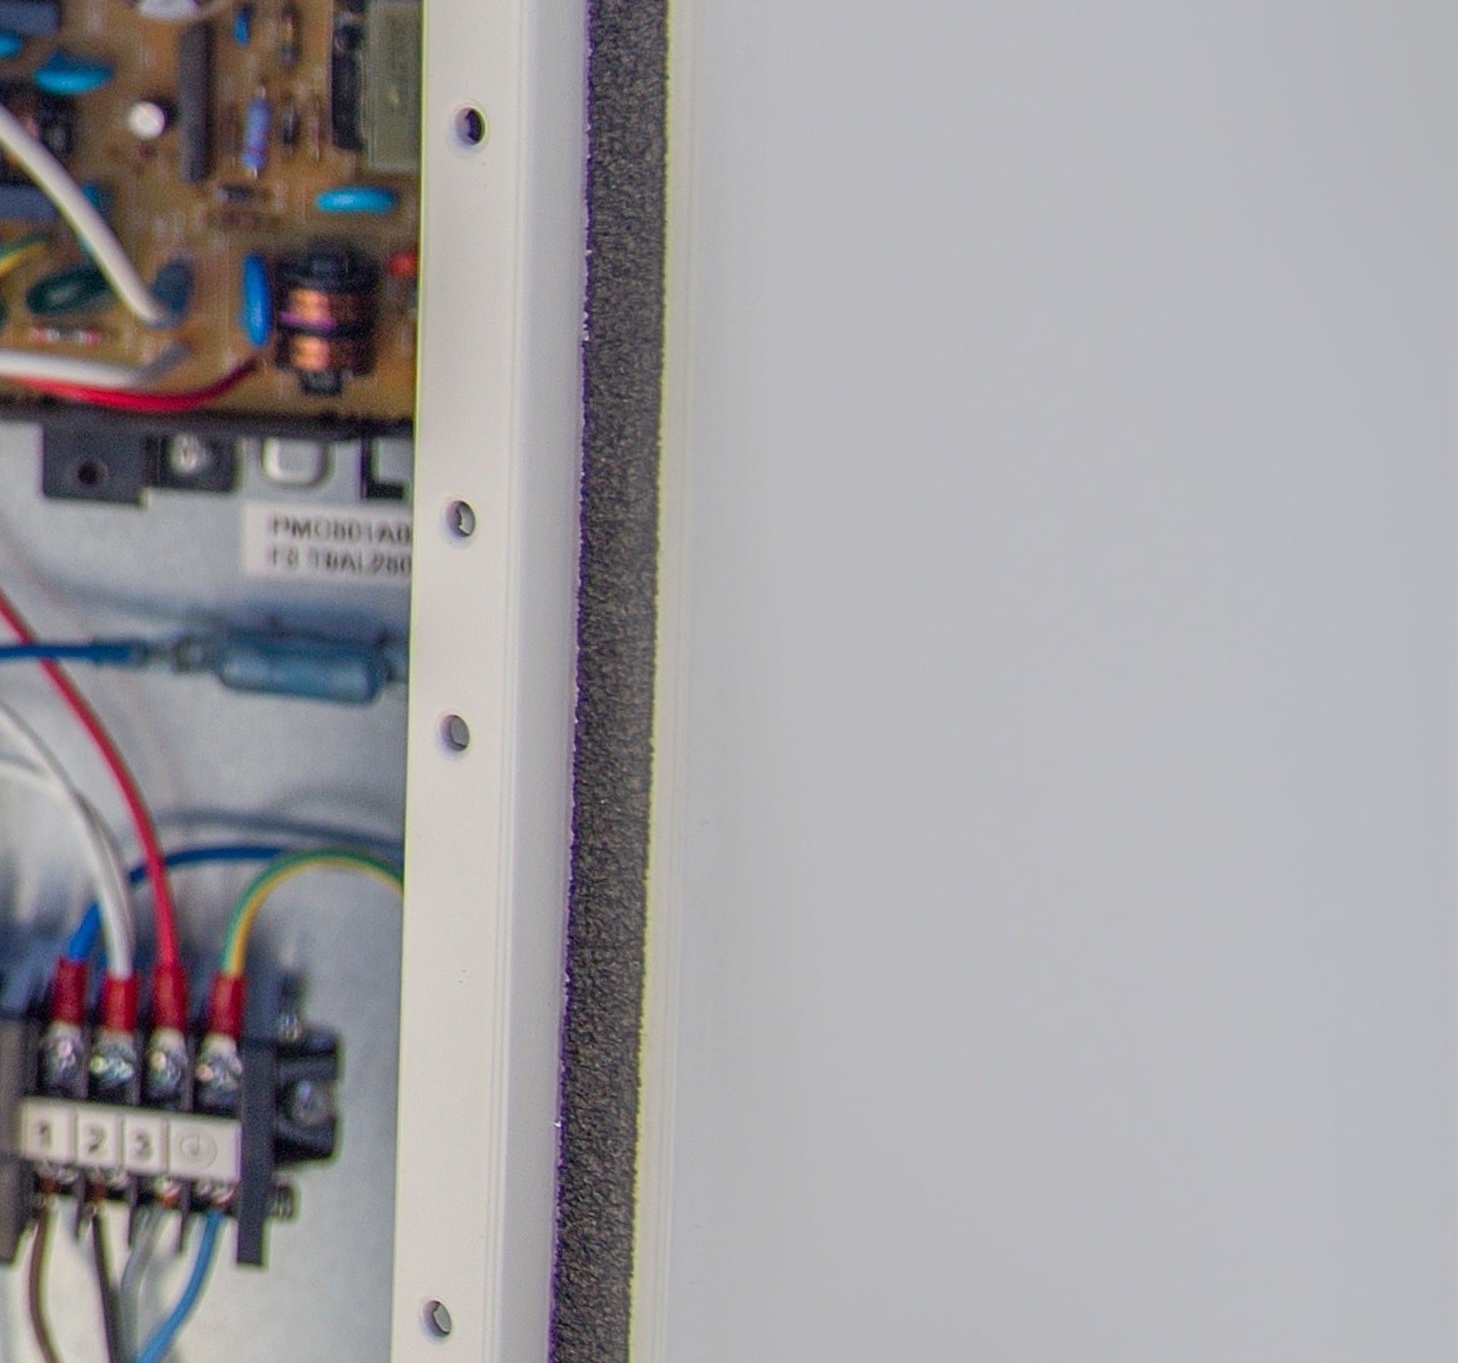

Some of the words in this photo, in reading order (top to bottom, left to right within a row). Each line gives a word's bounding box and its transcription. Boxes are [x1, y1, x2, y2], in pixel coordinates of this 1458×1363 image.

[38, 1120, 54, 1148] 1
[88, 1122, 108, 1154] 2
[135, 1128, 154, 1160] 3
